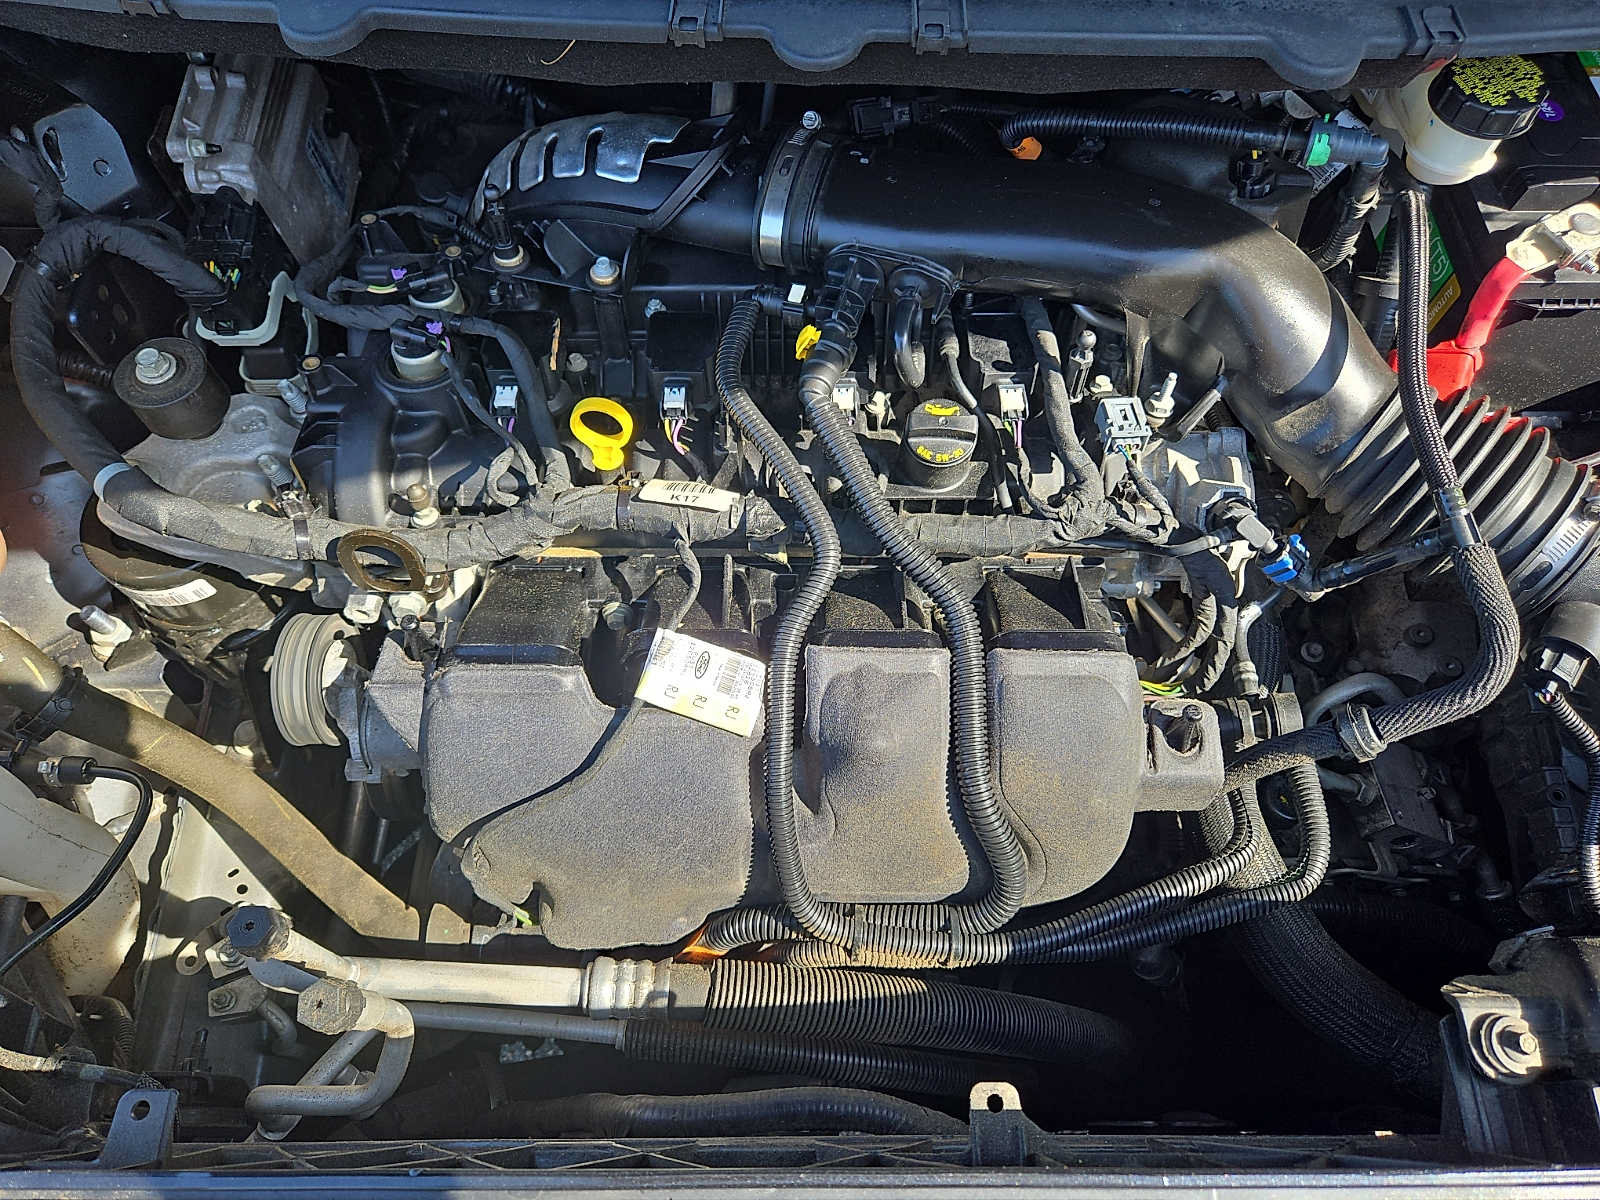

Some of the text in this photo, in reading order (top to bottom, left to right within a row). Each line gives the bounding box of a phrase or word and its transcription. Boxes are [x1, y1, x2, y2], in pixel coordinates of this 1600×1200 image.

[1427, 285, 1454, 321] AUTOMO
[670, 494, 700, 503] K17
[696, 653, 709, 676] Ford
[692, 694, 707, 709] RJ
[725, 705, 740, 720] RJ
